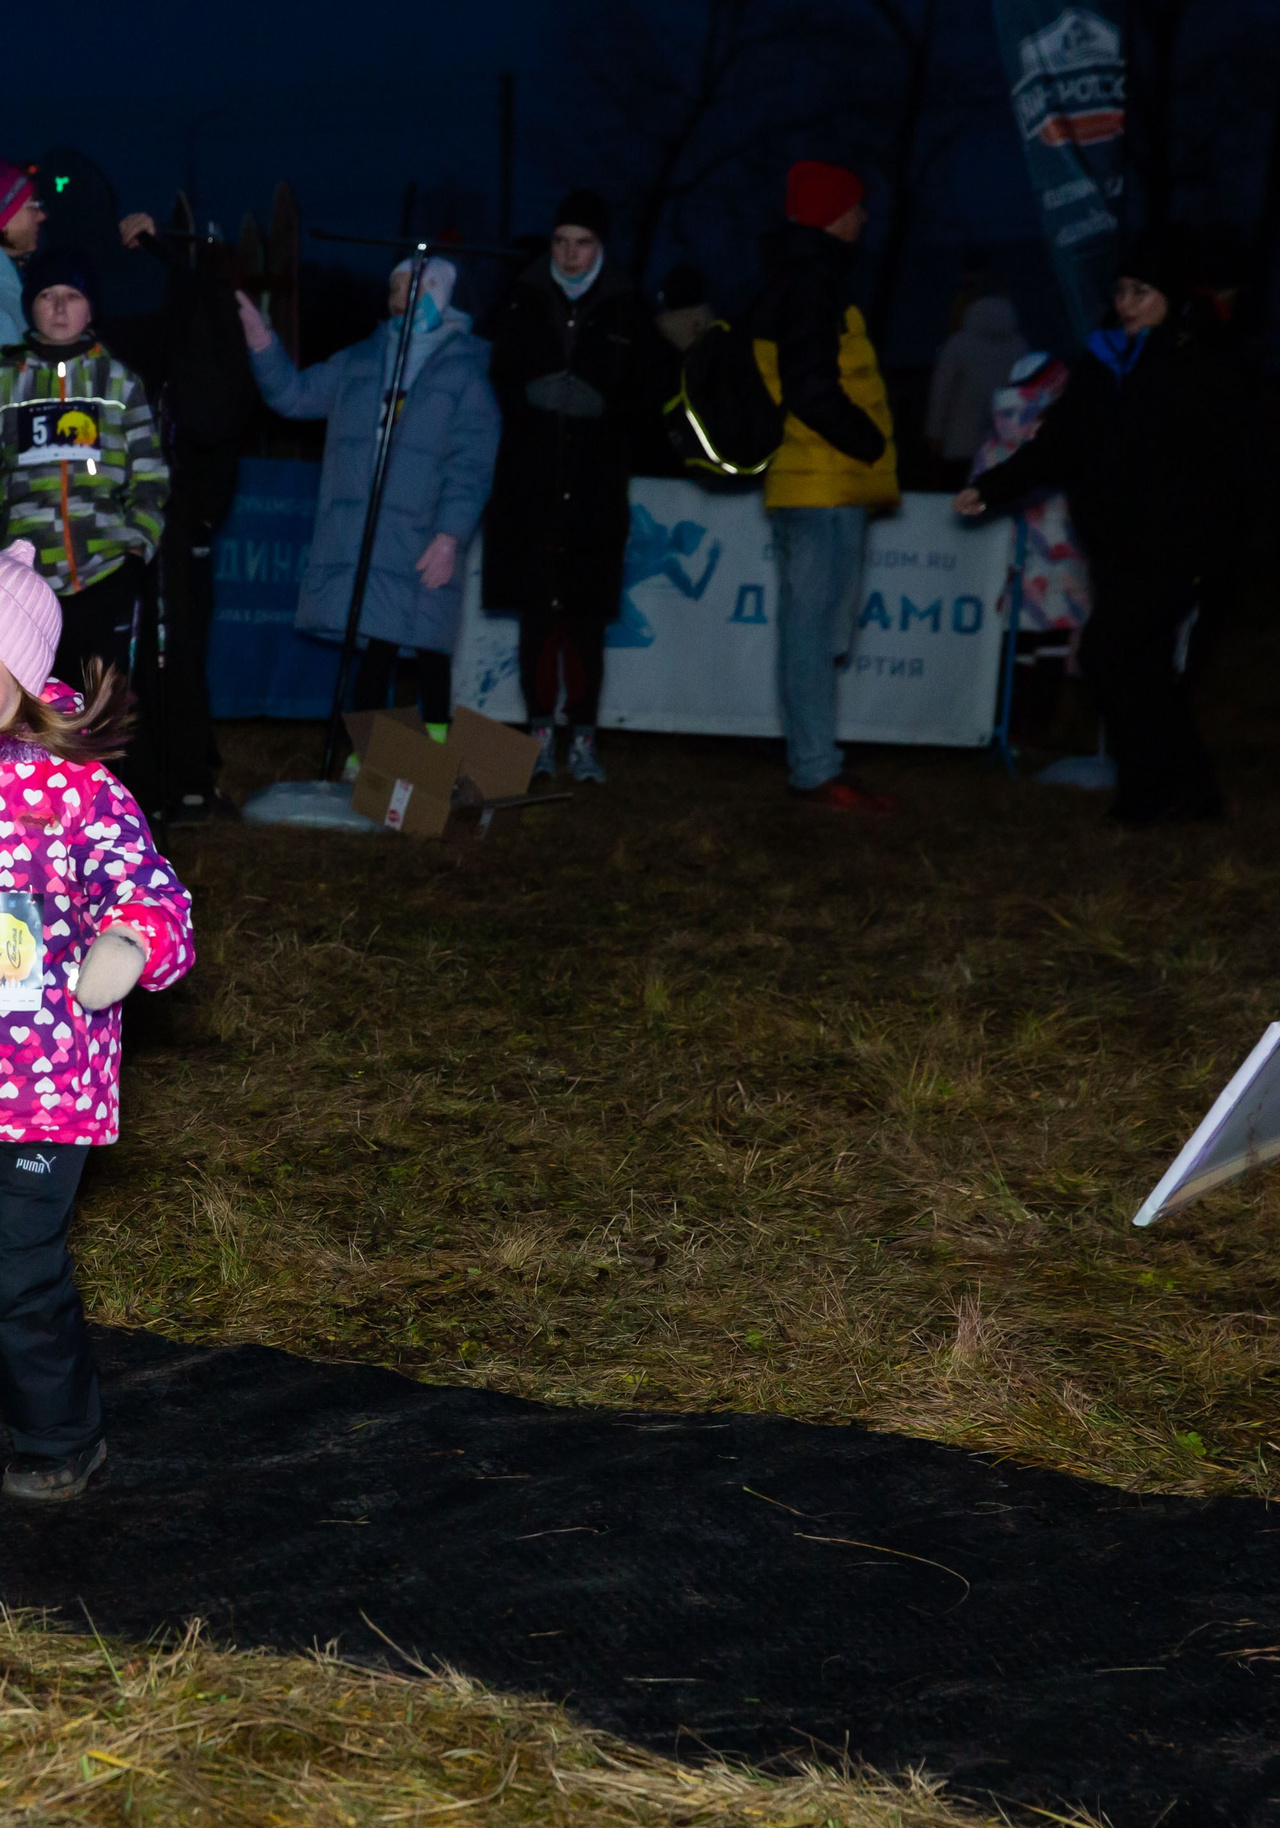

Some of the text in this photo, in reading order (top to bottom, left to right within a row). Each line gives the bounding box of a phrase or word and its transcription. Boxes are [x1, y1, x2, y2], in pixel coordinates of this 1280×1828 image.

[32, 415, 48, 445] 5
[729, 585, 983, 634] ДАМО
[16, 1158, 45, 1173] PUMA
